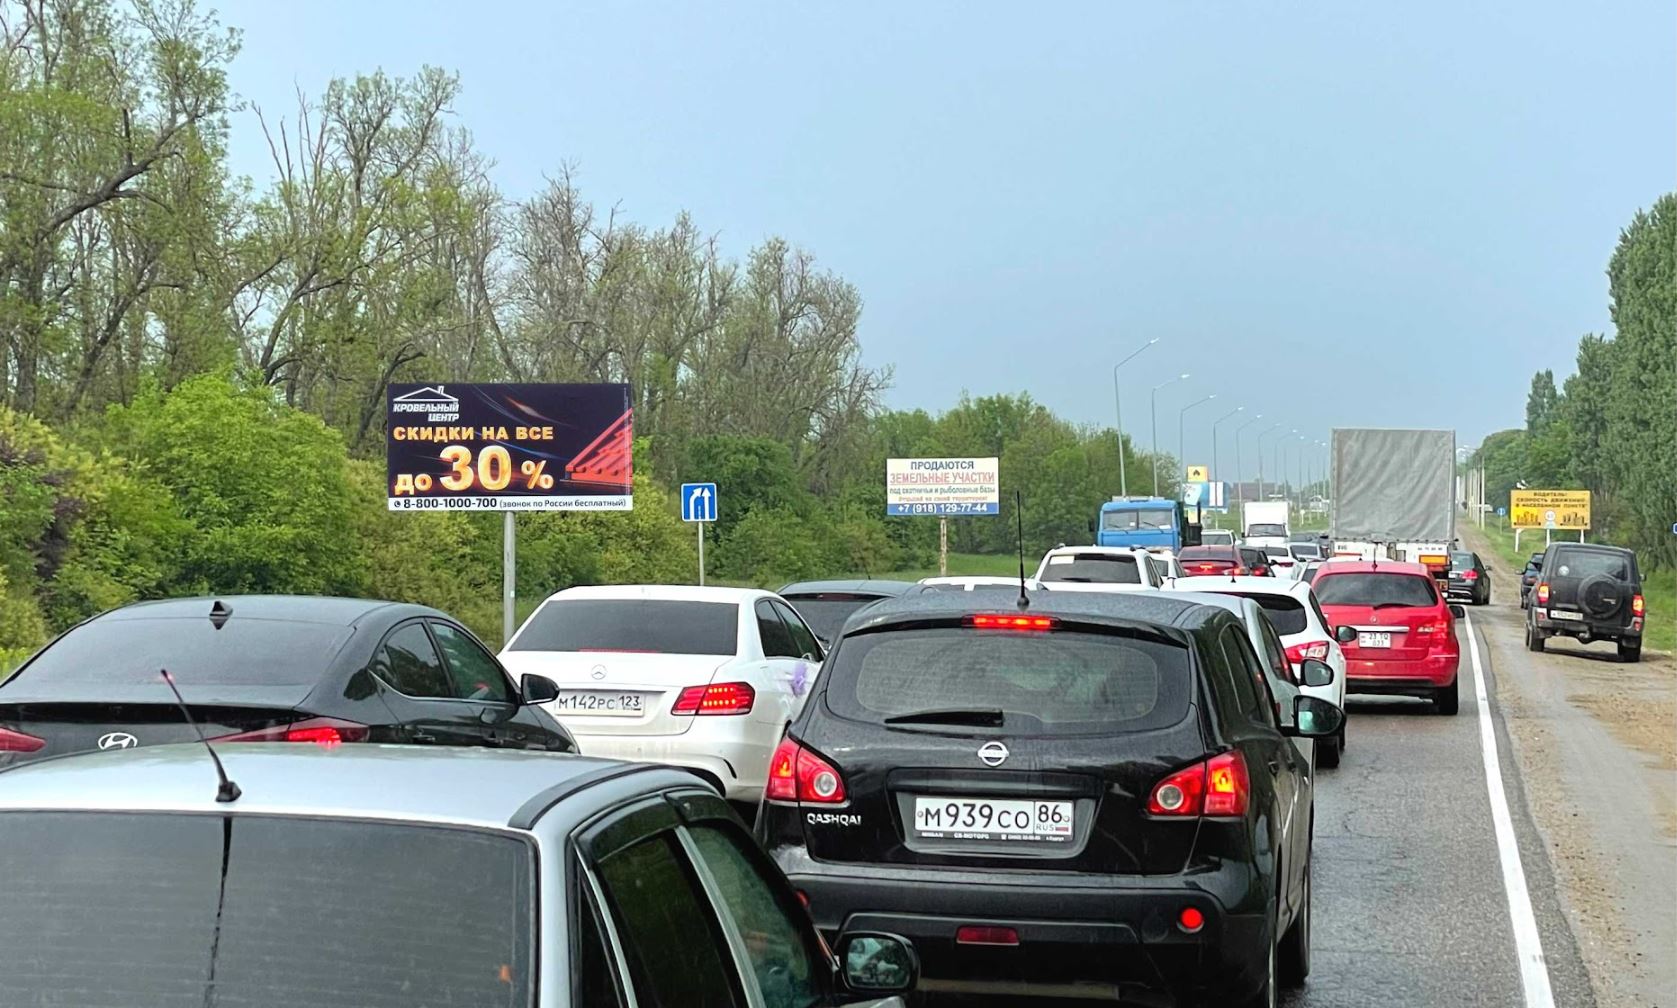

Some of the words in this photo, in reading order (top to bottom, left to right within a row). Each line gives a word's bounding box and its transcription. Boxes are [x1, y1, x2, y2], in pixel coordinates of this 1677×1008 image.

[393, 401, 459, 412] КРОВЕЛЬНЫЙ
[428, 413, 460, 422] ЦЕНТР
[393, 426, 474, 443] СКИДКИ
[482, 426, 509, 440] НА
[516, 426, 554, 440] ВСЕ
[439, 445, 512, 491] 30
[521, 460, 554, 490] %
[910, 461, 974, 471] ПРОДАЮТСЯ
[890, 472, 950, 483] ЗЕМЕЛЬНЫЕ
[952, 471, 995, 483] УЧАСТКИ
[403, 498, 497, 509] 8-800-1000-700
[500, 500, 531, 508] (звонок
[575, 498, 627, 507] бесплатный)
[898, 504, 911, 513] +7
[912, 503, 937, 514] (918)
[940, 503, 988, 513] 129-77-44
[619, 695, 640, 707] 123
[806, 812, 862, 827] QASHQAI
[1038, 804, 1062, 824] 86
